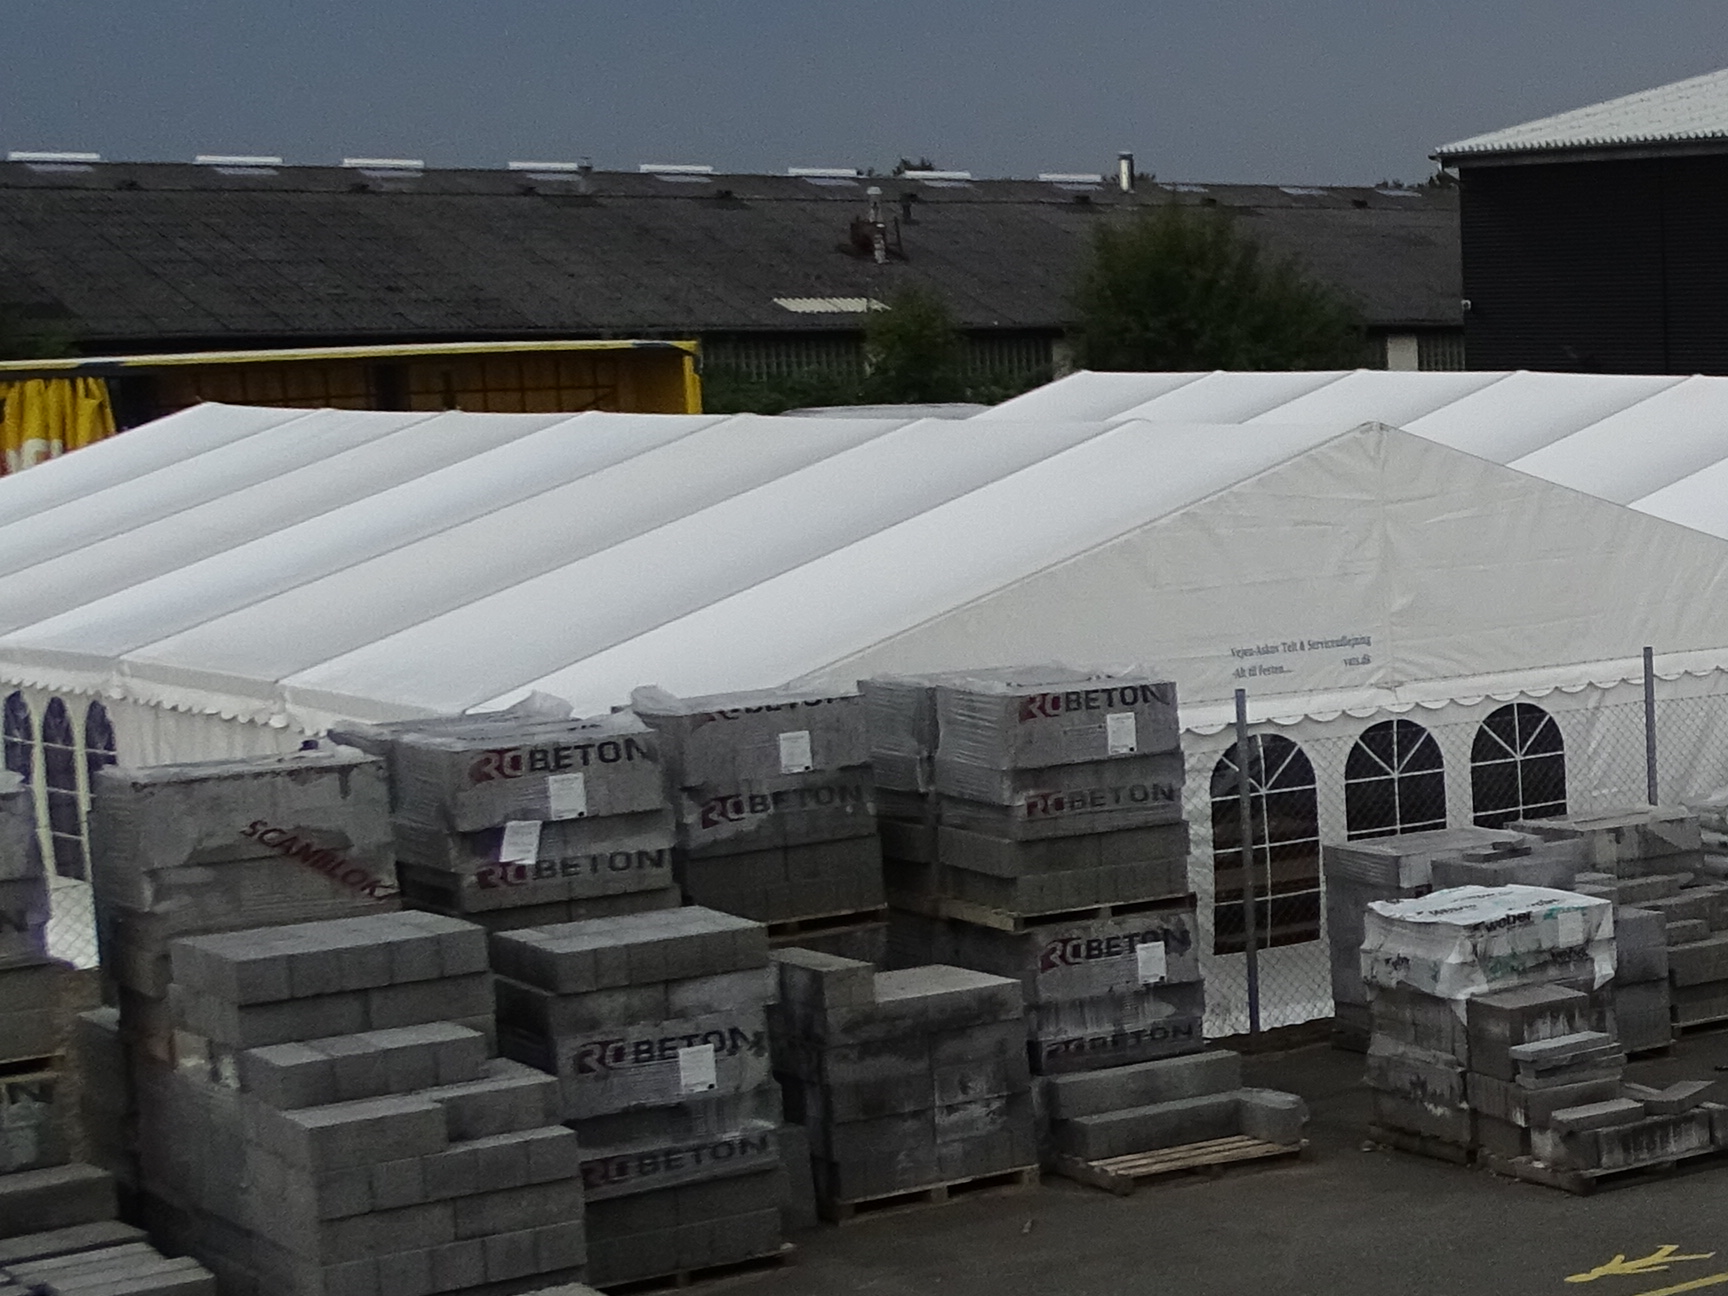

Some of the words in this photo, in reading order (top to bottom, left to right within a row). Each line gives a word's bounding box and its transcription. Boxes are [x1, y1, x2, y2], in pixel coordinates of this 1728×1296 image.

[1065, 681, 1177, 712] BETON
[529, 737, 658, 773] BETON
[1069, 783, 1175, 811] BETON
[533, 849, 665, 881] BETON
[1484, 910, 1533, 932] weber
[638, 1134, 769, 1176] BETON
